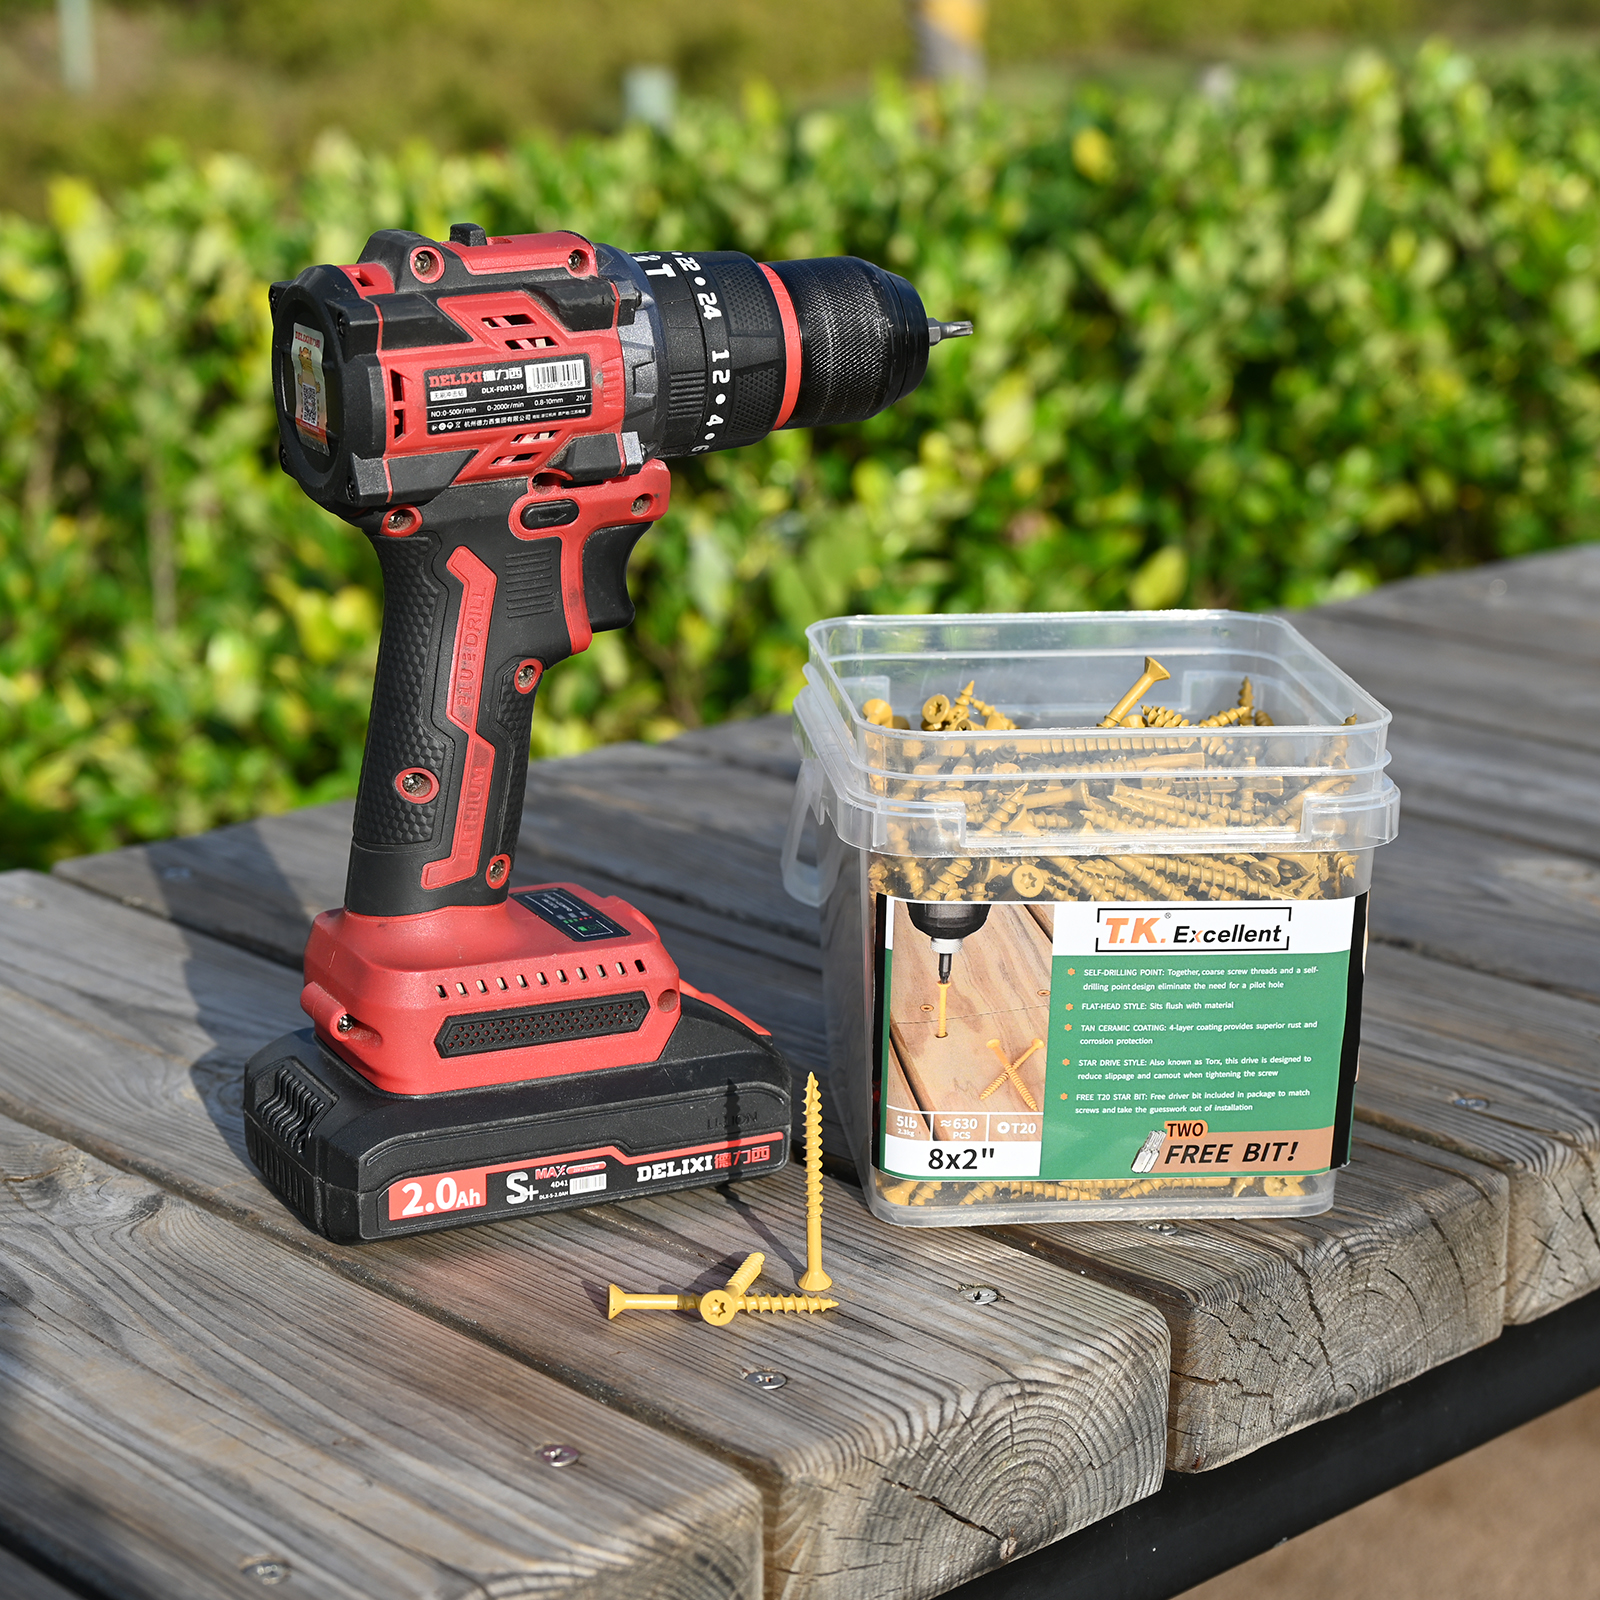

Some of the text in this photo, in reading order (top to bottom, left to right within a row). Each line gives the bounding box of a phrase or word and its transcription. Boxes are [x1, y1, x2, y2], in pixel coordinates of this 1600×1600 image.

[675, 257, 701, 271] 22
[697, 292, 722, 320] 24
[428, 371, 482, 388] DELIXI
[481, 383, 524, 394] DLX-FDR1249
[430, 394, 587, 418] NO:0-500r/min 0-2000r/min 0.8-10mm 21V
[706, 414, 724, 427] 4
[464, 586, 488, 648] DRILL
[1173, 924, 1282, 943] Excellent
[1083, 968, 1138, 977] SELF-DRILLING
[1139, 968, 1165, 977] POINT:
[1167, 968, 1201, 978] Together,
[1226, 968, 1249, 976] screw
[1250, 966, 1278, 975] threads
[1279, 966, 1294, 975] and
[1303, 965, 1319, 974] self-
[1082, 982, 1110, 993] drilling
[1111, 982, 1131, 993] point
[1131, 981, 1156, 992] design
[1157, 981, 1192, 990] eliminate
[1193, 981, 1206, 990] the
[1208, 981, 1227, 990] need
[1228, 981, 1240, 989] for
[1248, 980, 1266, 991] pilot
[1268, 980, 1285, 989] hole
[1081, 1000, 1235, 1011] FLAT-HEAD STYLE: Sits flush with material
[1080, 1020, 1318, 1033] TAN CERAMIC COATING: 4-layer coating provides superior rust and
[1079, 1037, 1154, 1047] corrosion protection
[1077, 1059, 1098, 1067] STAR
[1099, 1059, 1122, 1067] DRIVE
[1123, 1058, 1148, 1067] STYLE:
[1148, 1058, 1166, 1067] Also
[1167, 1058, 1192, 1066] known
[1205, 1057, 1223, 1066] Torx,
[1224, 1057, 1239, 1065] this
[1240, 1056, 1260, 1065] drive
[1260, 1056, 1268, 1064] is
[1269, 1055, 1302, 1065] designed
[1303, 1055, 1313, 1063] to
[1077, 1072, 1103, 1080] reduce
[1104, 1072, 1135, 1082] slippage
[1136, 1071, 1152, 1080] and
[1153, 1072, 1182, 1080] camout
[1182, 1071, 1204, 1079] when
[1205, 1070, 1242, 1080] tightening
[1243, 1069, 1256, 1078] the
[1075, 1088, 1311, 1101] FREE T20 STAR BIT: Free driver bit included in package to match
[1101, 1106, 1117, 1114] and
[1116, 1106, 1133, 1114] take
[1134, 1105, 1148, 1114] the
[1148, 1104, 1188, 1115] guesswork
[1189, 1105, 1203, 1113] out
[1203, 1103, 1213, 1112] of
[1214, 1103, 1254, 1112] installation
[896, 1116, 918, 1129] 5lb
[1011, 1123, 1037, 1134] T20
[952, 1132, 971, 1140] PCS
[1167, 1123, 1204, 1137] TWO
[714, 1145, 771, 1169] 德力西
[1164, 1141, 1299, 1165] FREE BIT!
[535, 1164, 567, 1180] MAX
[636, 1154, 714, 1183] DELIXI
[550, 1180, 568, 1189] 4D41
[401, 1177, 481, 1216] 2.0Ah
